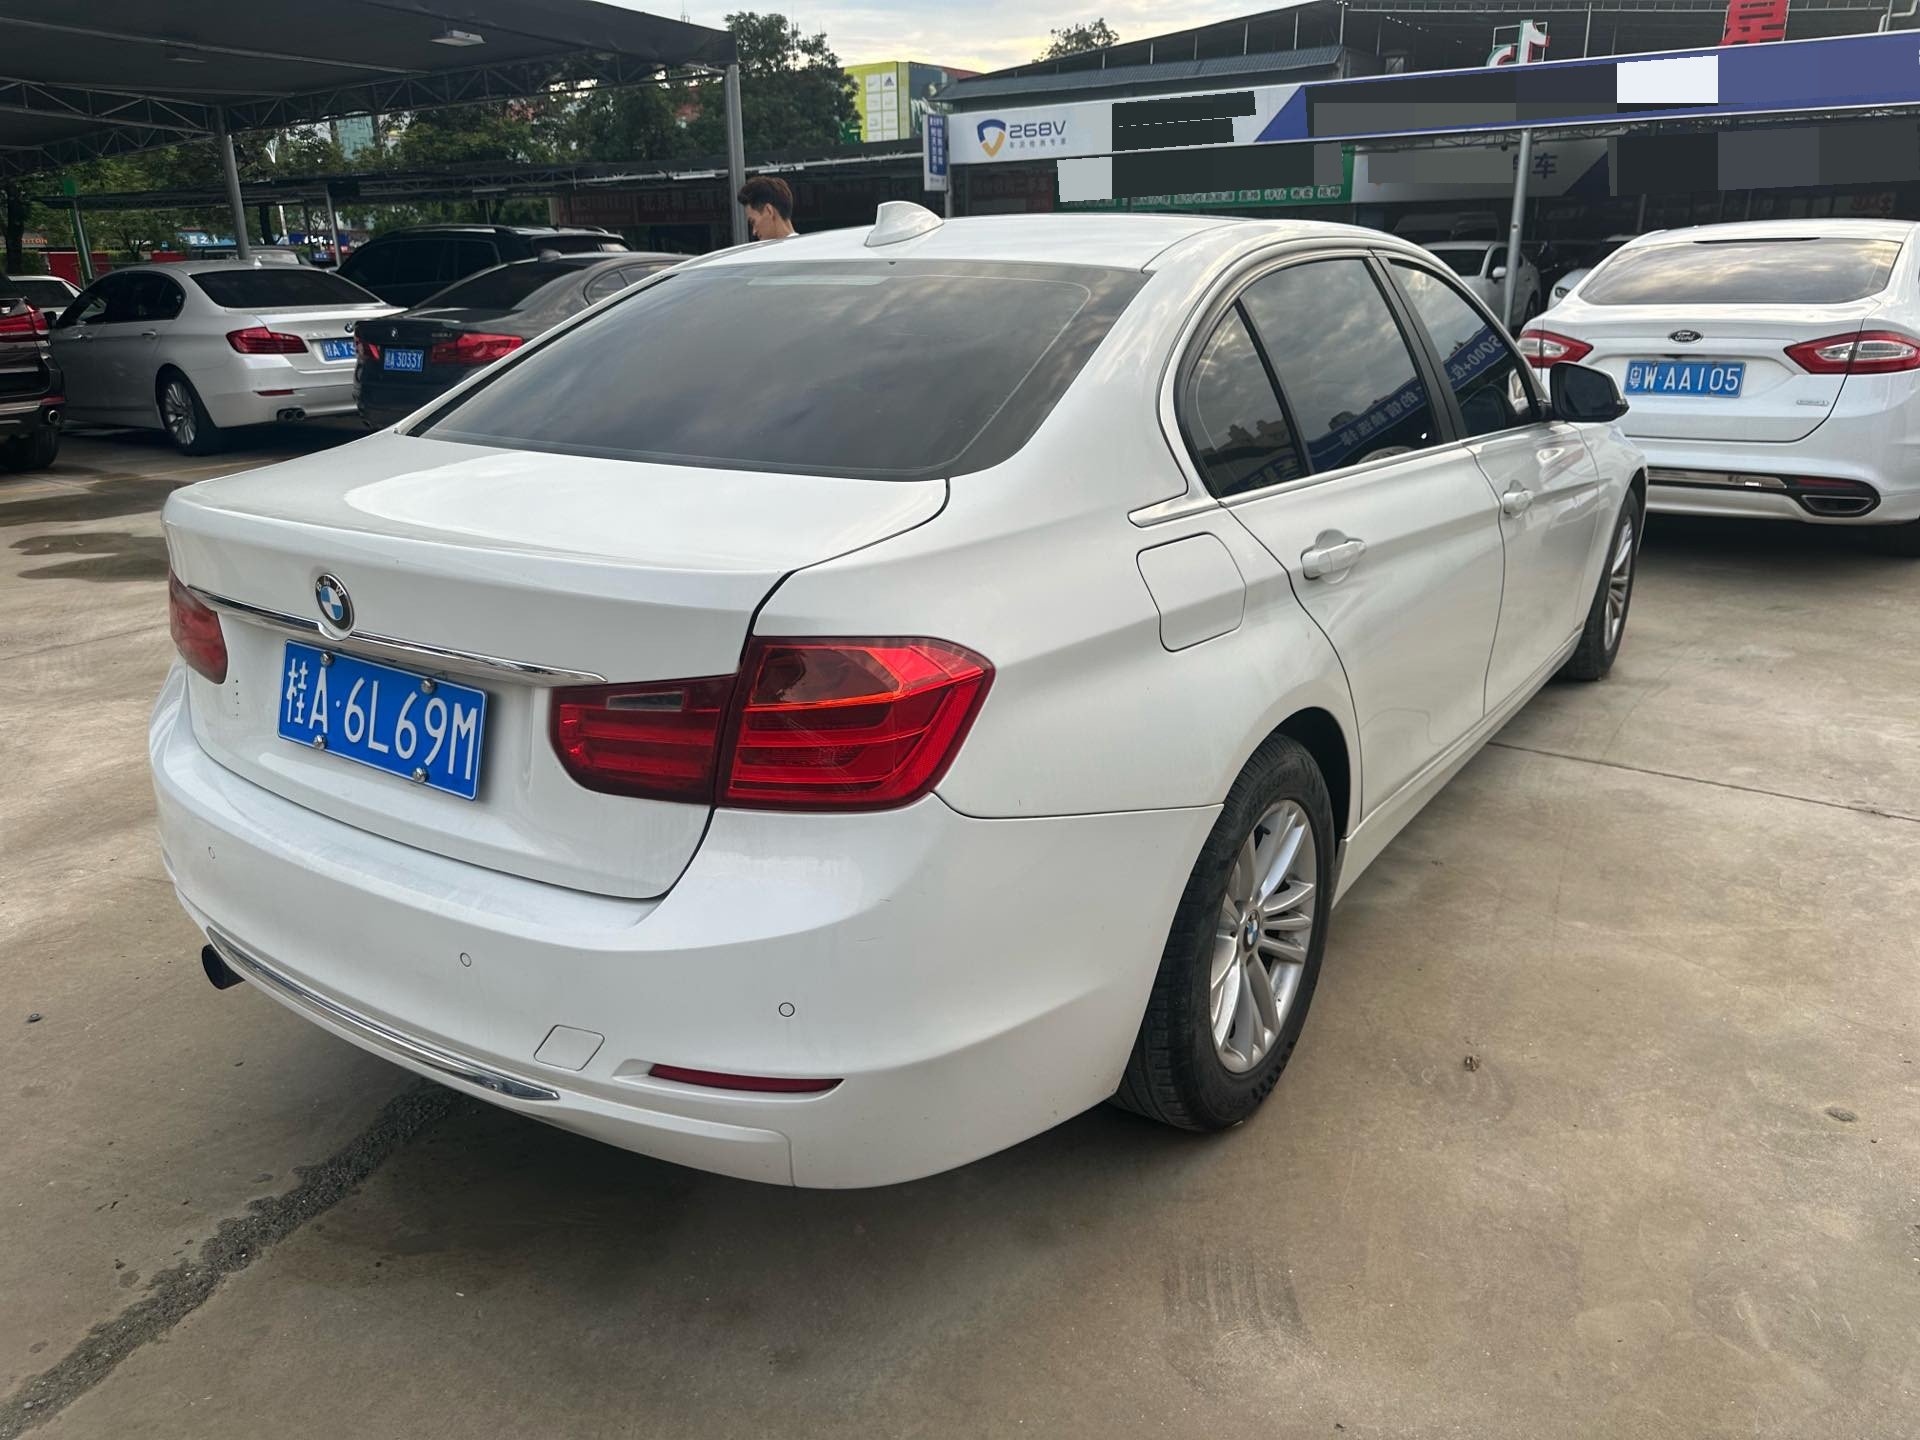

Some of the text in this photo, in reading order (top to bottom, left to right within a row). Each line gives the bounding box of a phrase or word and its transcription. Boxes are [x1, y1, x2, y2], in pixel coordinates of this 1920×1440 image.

[1009, 120, 1066, 138] 268V
[1673, 331, 1698, 341] Ford
[286, 658, 478, 780] 桂A·6L69M
